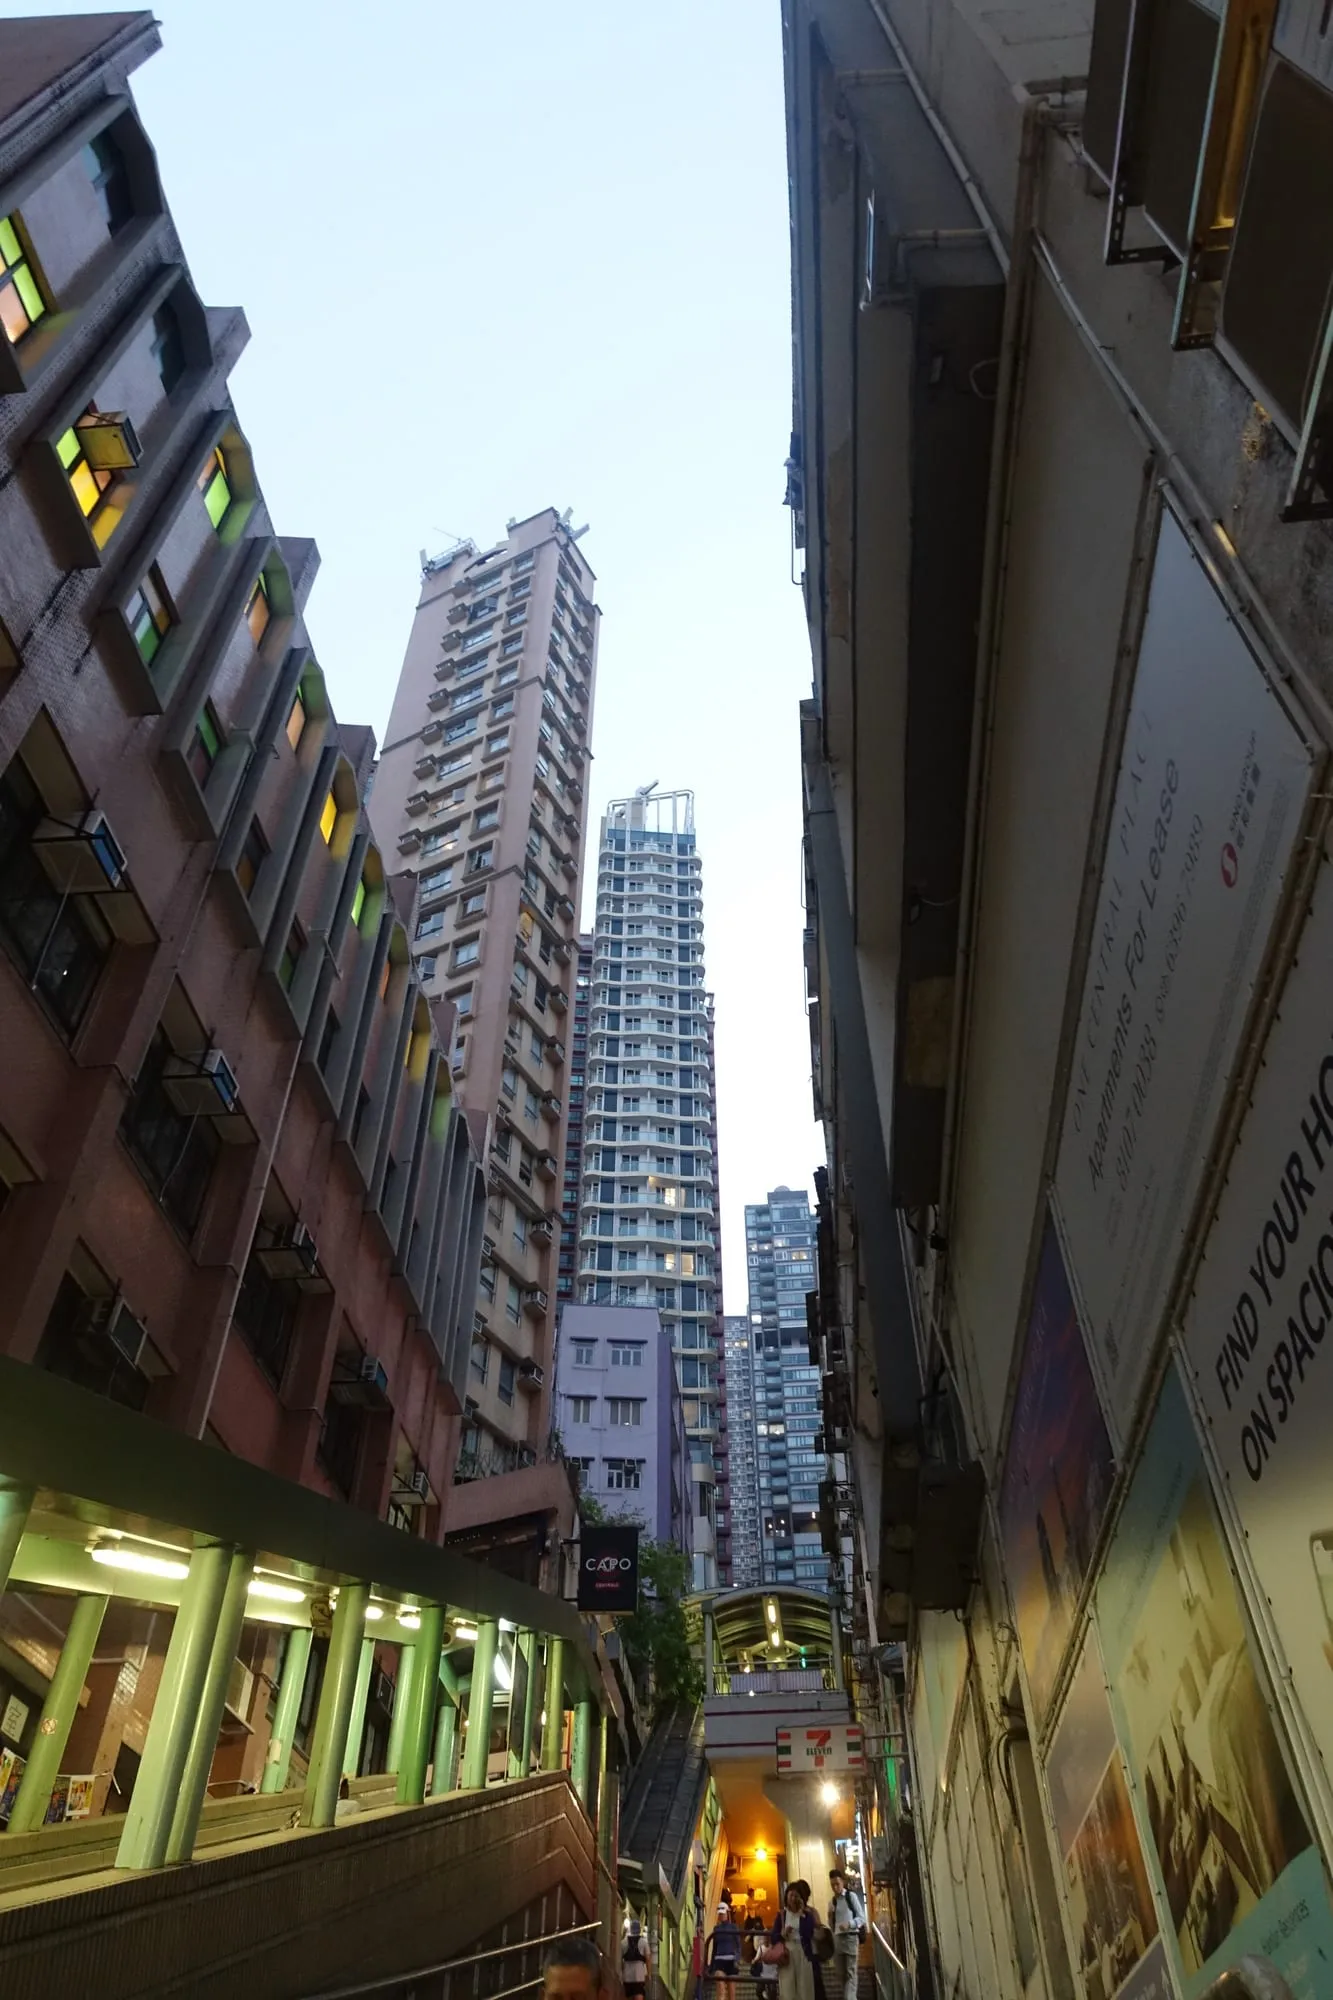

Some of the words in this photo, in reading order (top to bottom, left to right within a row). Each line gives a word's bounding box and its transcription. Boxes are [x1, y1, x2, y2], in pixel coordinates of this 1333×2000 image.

[1088, 992, 1133, 1192] Apartments
[1125, 909, 1148, 992] For
[1140, 758, 1179, 910] Lease
[1215, 1292, 1259, 1411] FIND
[1249, 1151, 1316, 1307] YOUR
[1301, 1032, 1333, 1172] HO
[1241, 1391, 1276, 1483] ON
[1266, 1210, 1333, 1424] SPACIO
[585, 1557, 632, 1572] CAPO
[806, 1730, 831, 1767] 7
